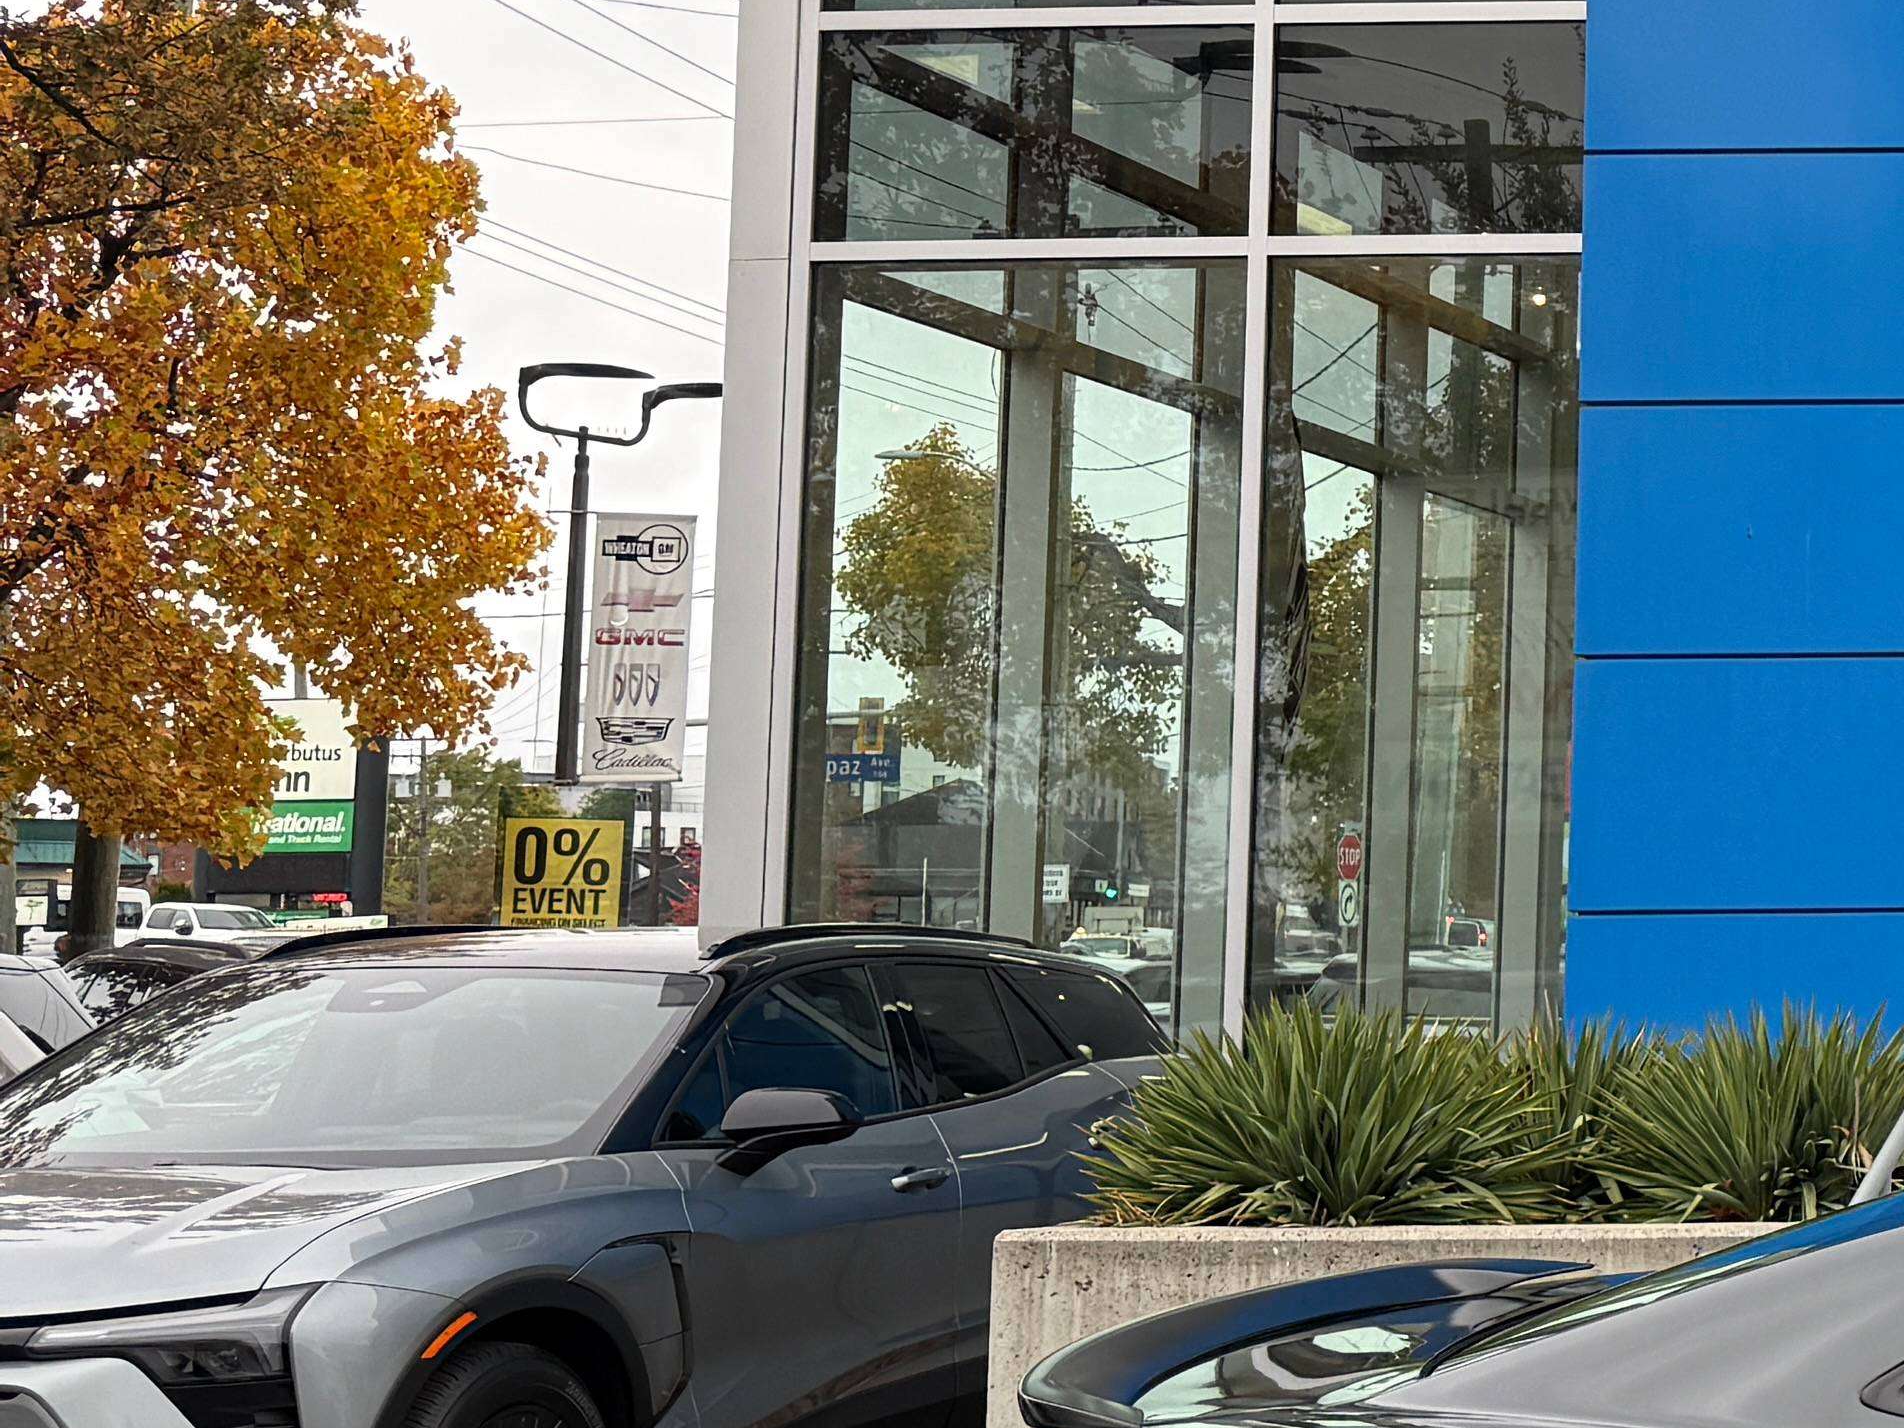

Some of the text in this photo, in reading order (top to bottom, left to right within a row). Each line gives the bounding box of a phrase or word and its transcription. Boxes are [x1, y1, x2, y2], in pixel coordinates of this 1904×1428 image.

[596, 628, 685, 646] GMC
[284, 743, 342, 761] rbutus
[592, 748, 672, 770] Cadillac
[273, 770, 310, 793] nn
[826, 760, 860, 782] paz
[514, 826, 610, 886] 0%
[1340, 847, 1360, 866] STOP
[512, 888, 607, 915] EVENT
